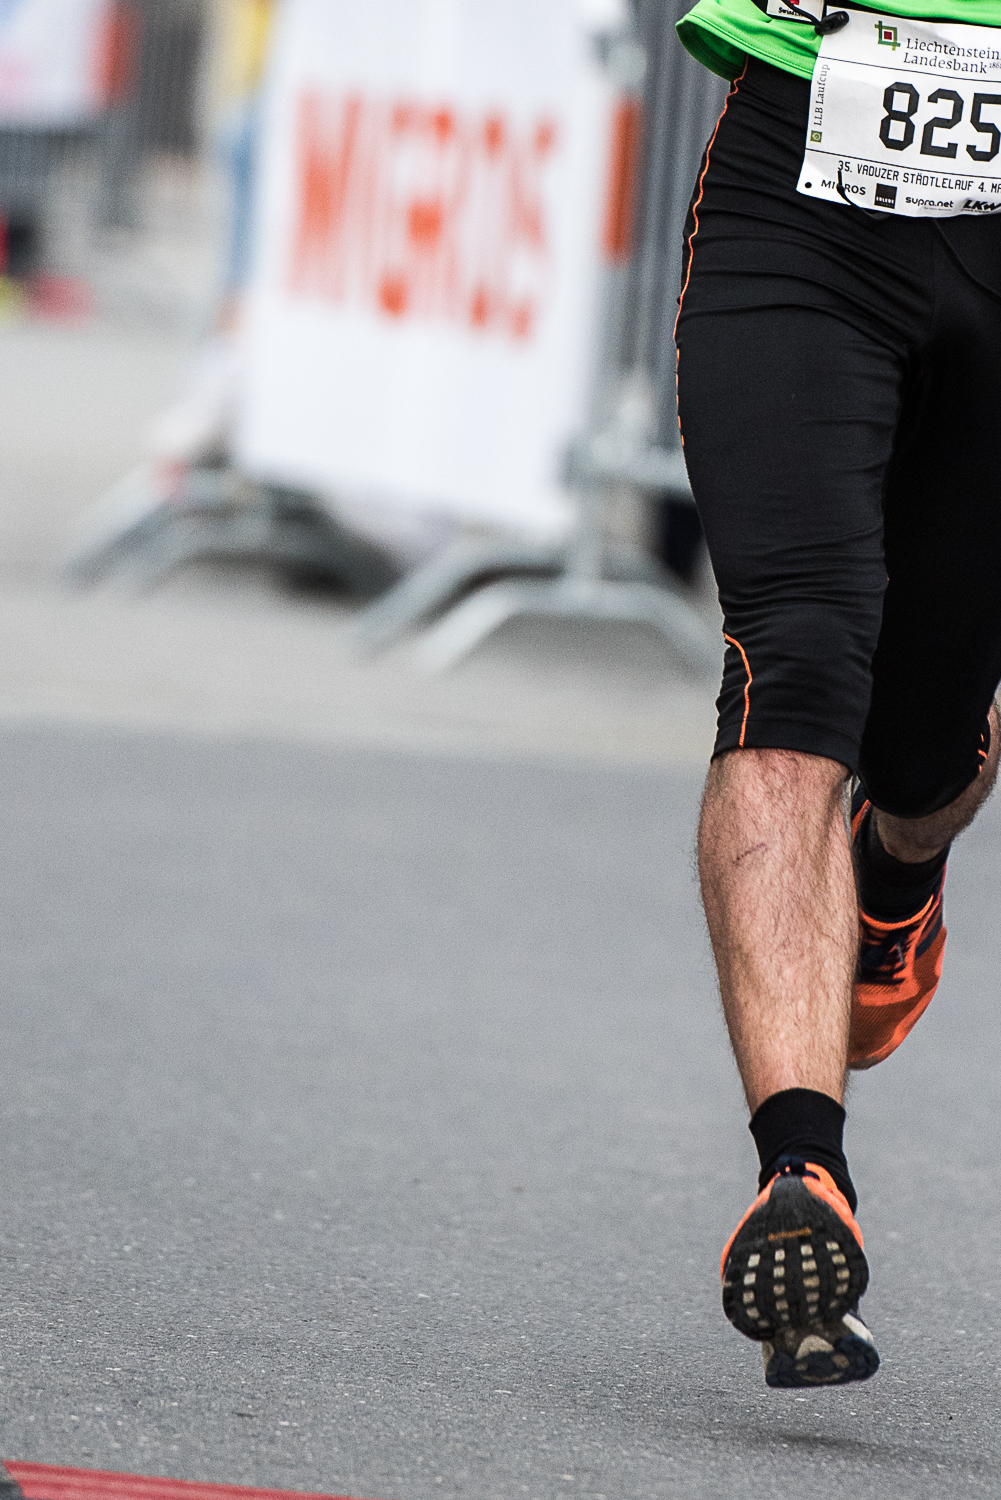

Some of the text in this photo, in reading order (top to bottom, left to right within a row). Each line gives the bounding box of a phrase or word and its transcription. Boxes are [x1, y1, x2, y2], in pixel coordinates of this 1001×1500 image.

[903, 52, 987, 74] Landesbank
[813, 64, 830, 127] LLB Laufcup
[820, 179, 867, 196] MIROS
[837, 160, 853, 174] 35.
[856, 164, 900, 181] VADUZER
[902, 171, 974, 192] STÄDTLELAUF
[978, 182, 988, 193] 4.
[905, 196, 954, 208] supra.net
